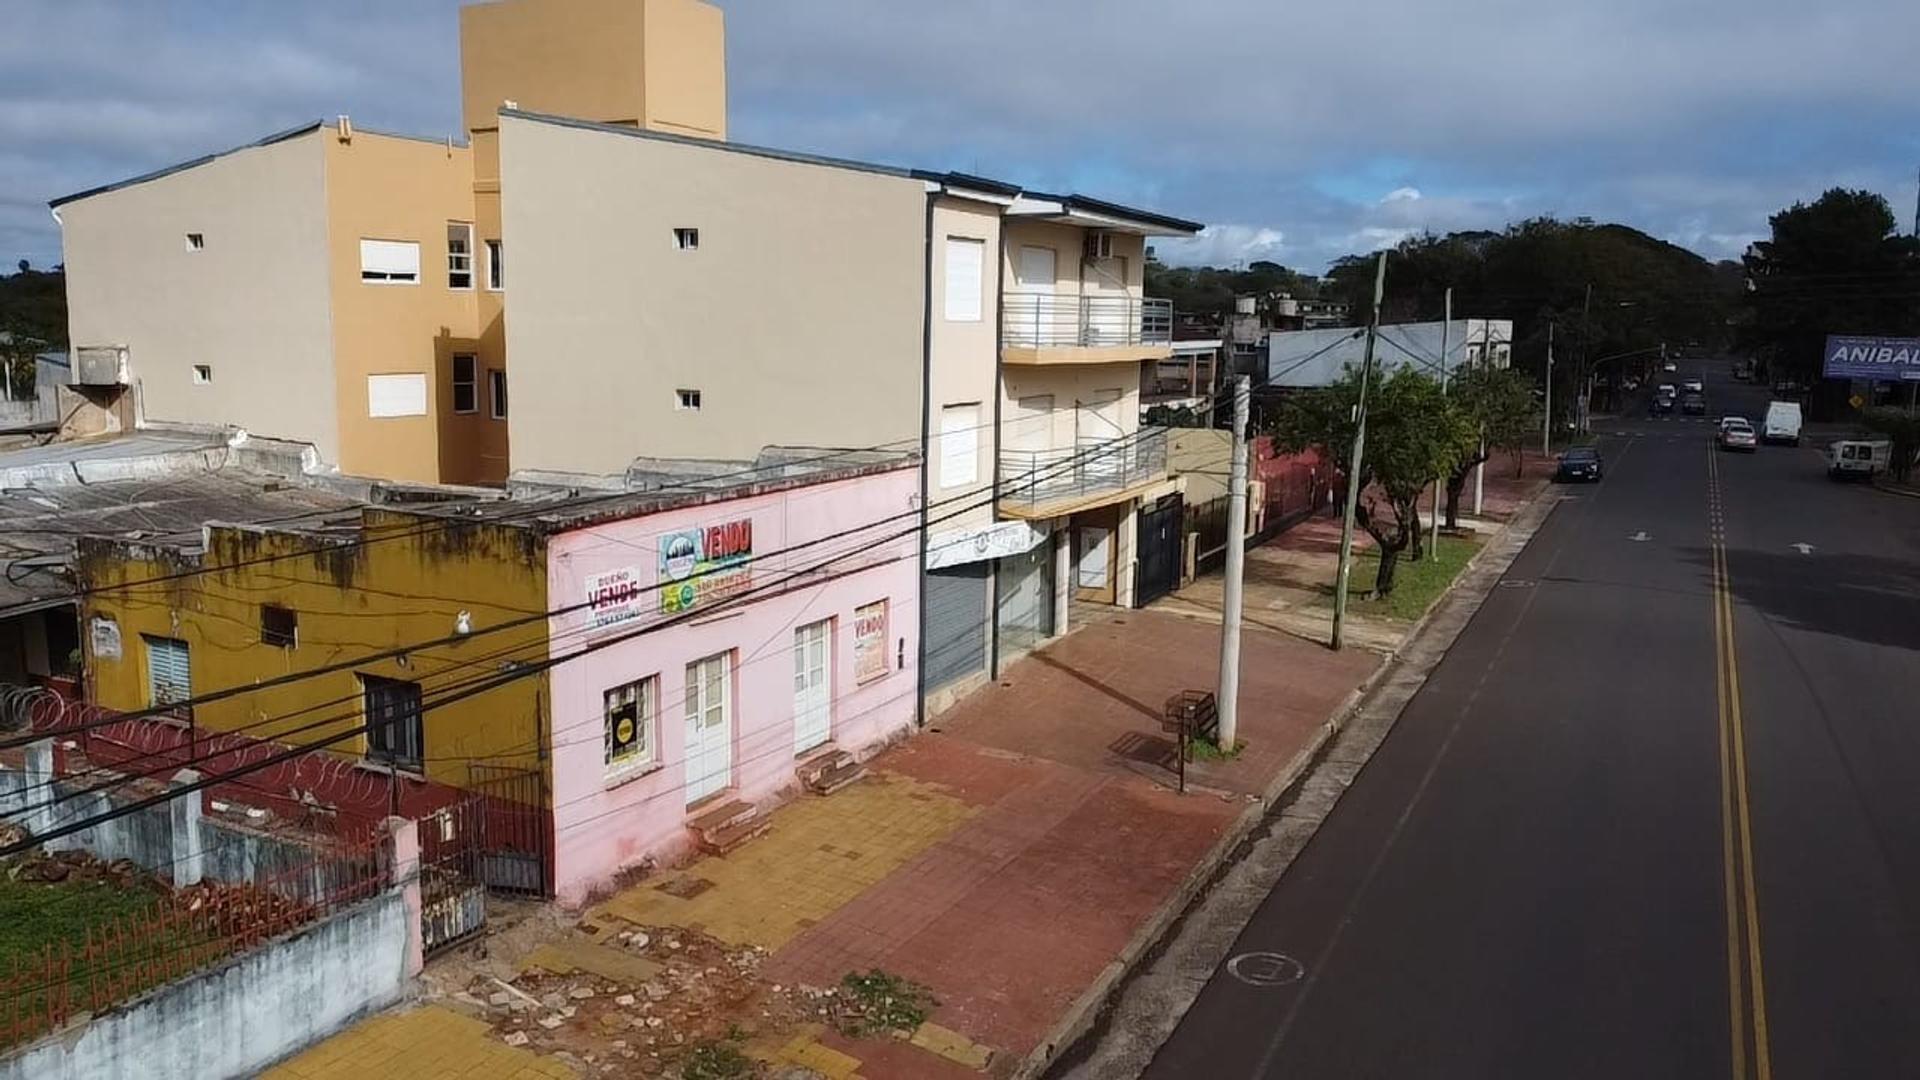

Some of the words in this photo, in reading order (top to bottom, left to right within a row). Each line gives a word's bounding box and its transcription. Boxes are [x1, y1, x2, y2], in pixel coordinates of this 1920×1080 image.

[1831, 345, 1920, 364] ANIBAL
[701, 520, 752, 561] VENDO
[588, 581, 638, 609] VENDE
[854, 614, 884, 638] VENDO
